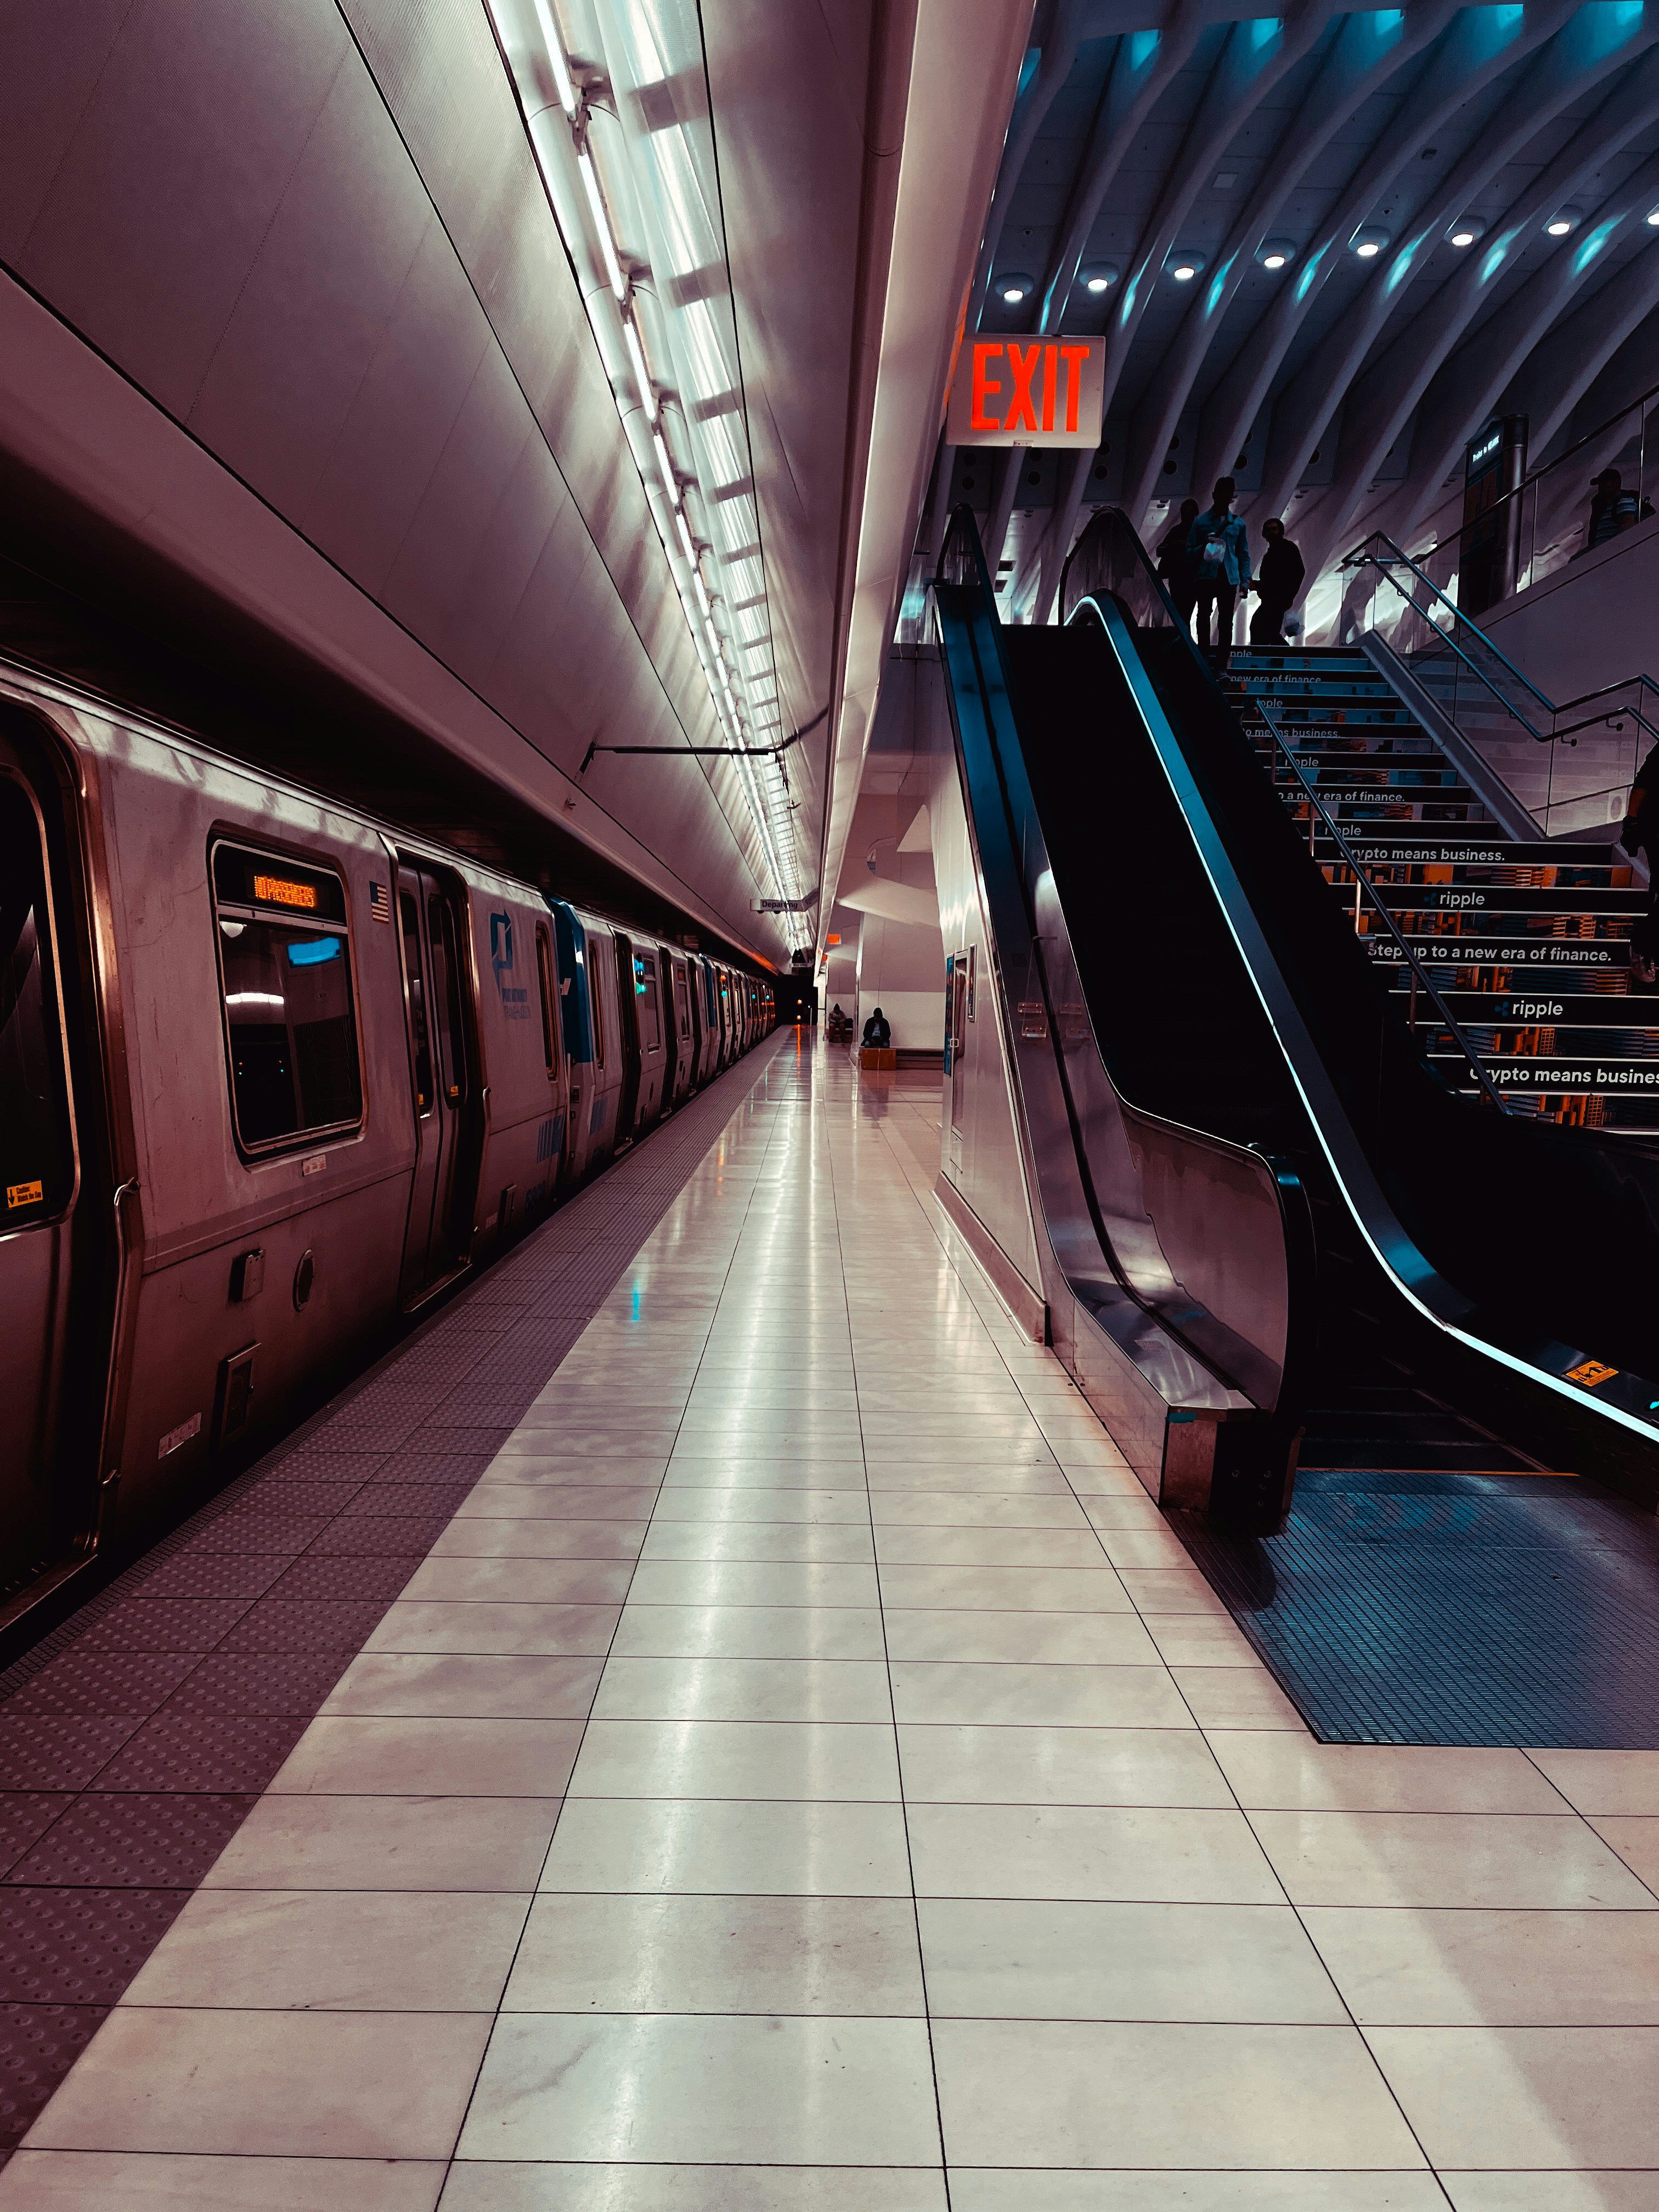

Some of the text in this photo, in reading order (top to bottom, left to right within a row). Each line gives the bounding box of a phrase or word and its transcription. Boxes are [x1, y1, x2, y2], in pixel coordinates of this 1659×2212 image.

[970, 343, 1090, 432] EXIT
[1229, 649, 1252, 657] pple
[1255, 729, 1289, 737] mens
[1285, 757, 1319, 768] rpple
[1323, 793, 1341, 801] era
[1345, 791, 1357, 801] of
[1359, 791, 1405, 802] finance.
[1325, 824, 1362, 838] rpple
[1340, 848, 1505, 861] rypto means business.
[762, 901, 798, 909] Departng
[1440, 892, 1485, 908] ripple
[1432, 946, 1447, 957] to
[1452, 949, 1460, 958] a
[1465, 949, 1497, 959] new
[1501, 949, 1526, 960] era
[1530, 946, 1546, 960] of
[1550, 947, 1611, 961] finance.
[1513, 1001, 1563, 1018] ripple
[1535, 1071, 1592, 1082] means
